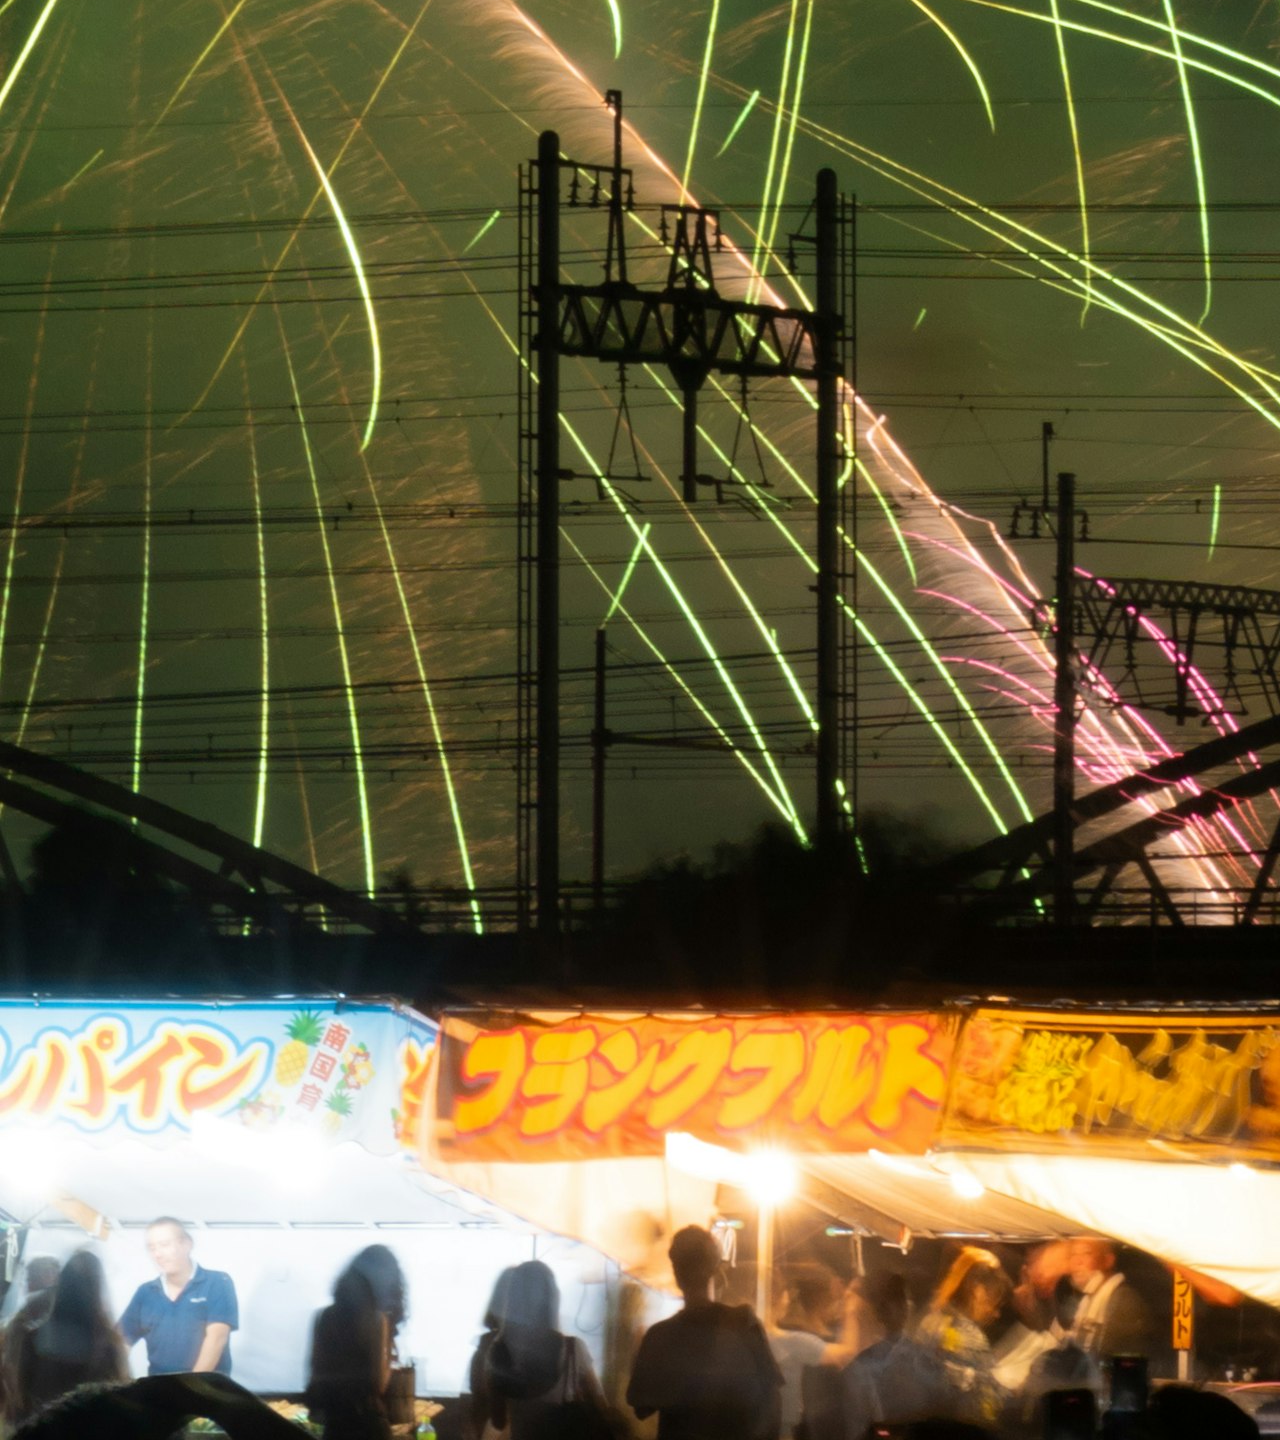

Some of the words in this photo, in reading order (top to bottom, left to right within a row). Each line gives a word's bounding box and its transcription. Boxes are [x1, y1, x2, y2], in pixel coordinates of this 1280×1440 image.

[0, 1029, 257, 1120] パイン
[455, 1025, 944, 1137] フランクフルト
